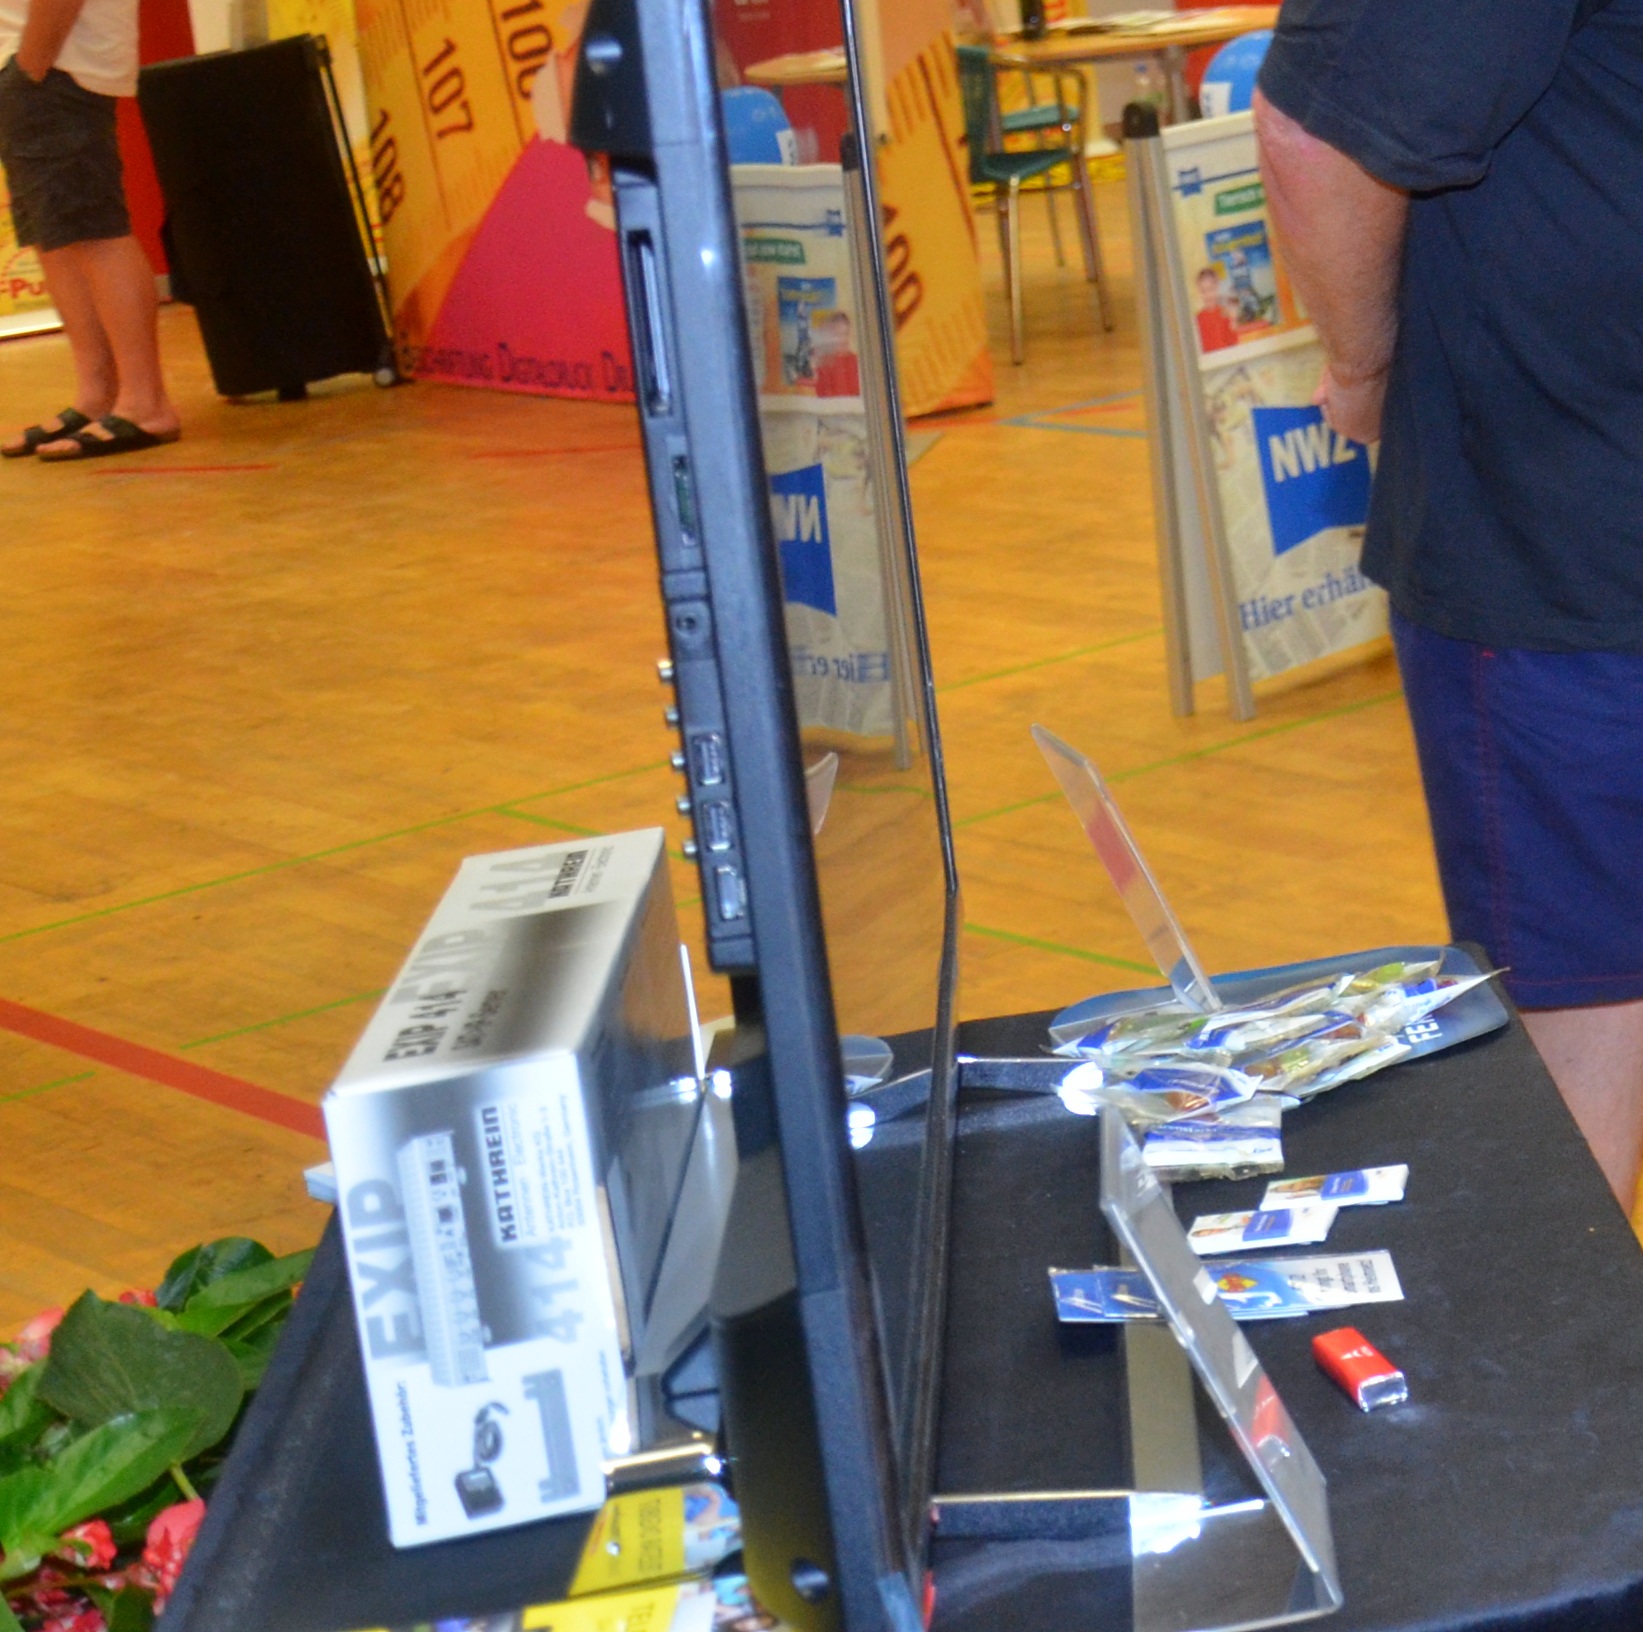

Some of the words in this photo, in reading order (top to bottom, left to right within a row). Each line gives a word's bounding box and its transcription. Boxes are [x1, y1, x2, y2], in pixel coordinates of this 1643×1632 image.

[422, 38, 475, 142] 107
[369, 108, 406, 225] 108
[1239, 592, 1297, 631] Hier
[383, 1023, 449, 1062] EXIP
[409, 989, 468, 1019] 414
[481, 1106, 518, 1244] KATHREIN
[346, 1179, 430, 1361] EXIP
[523, 1236, 584, 1344] 414
